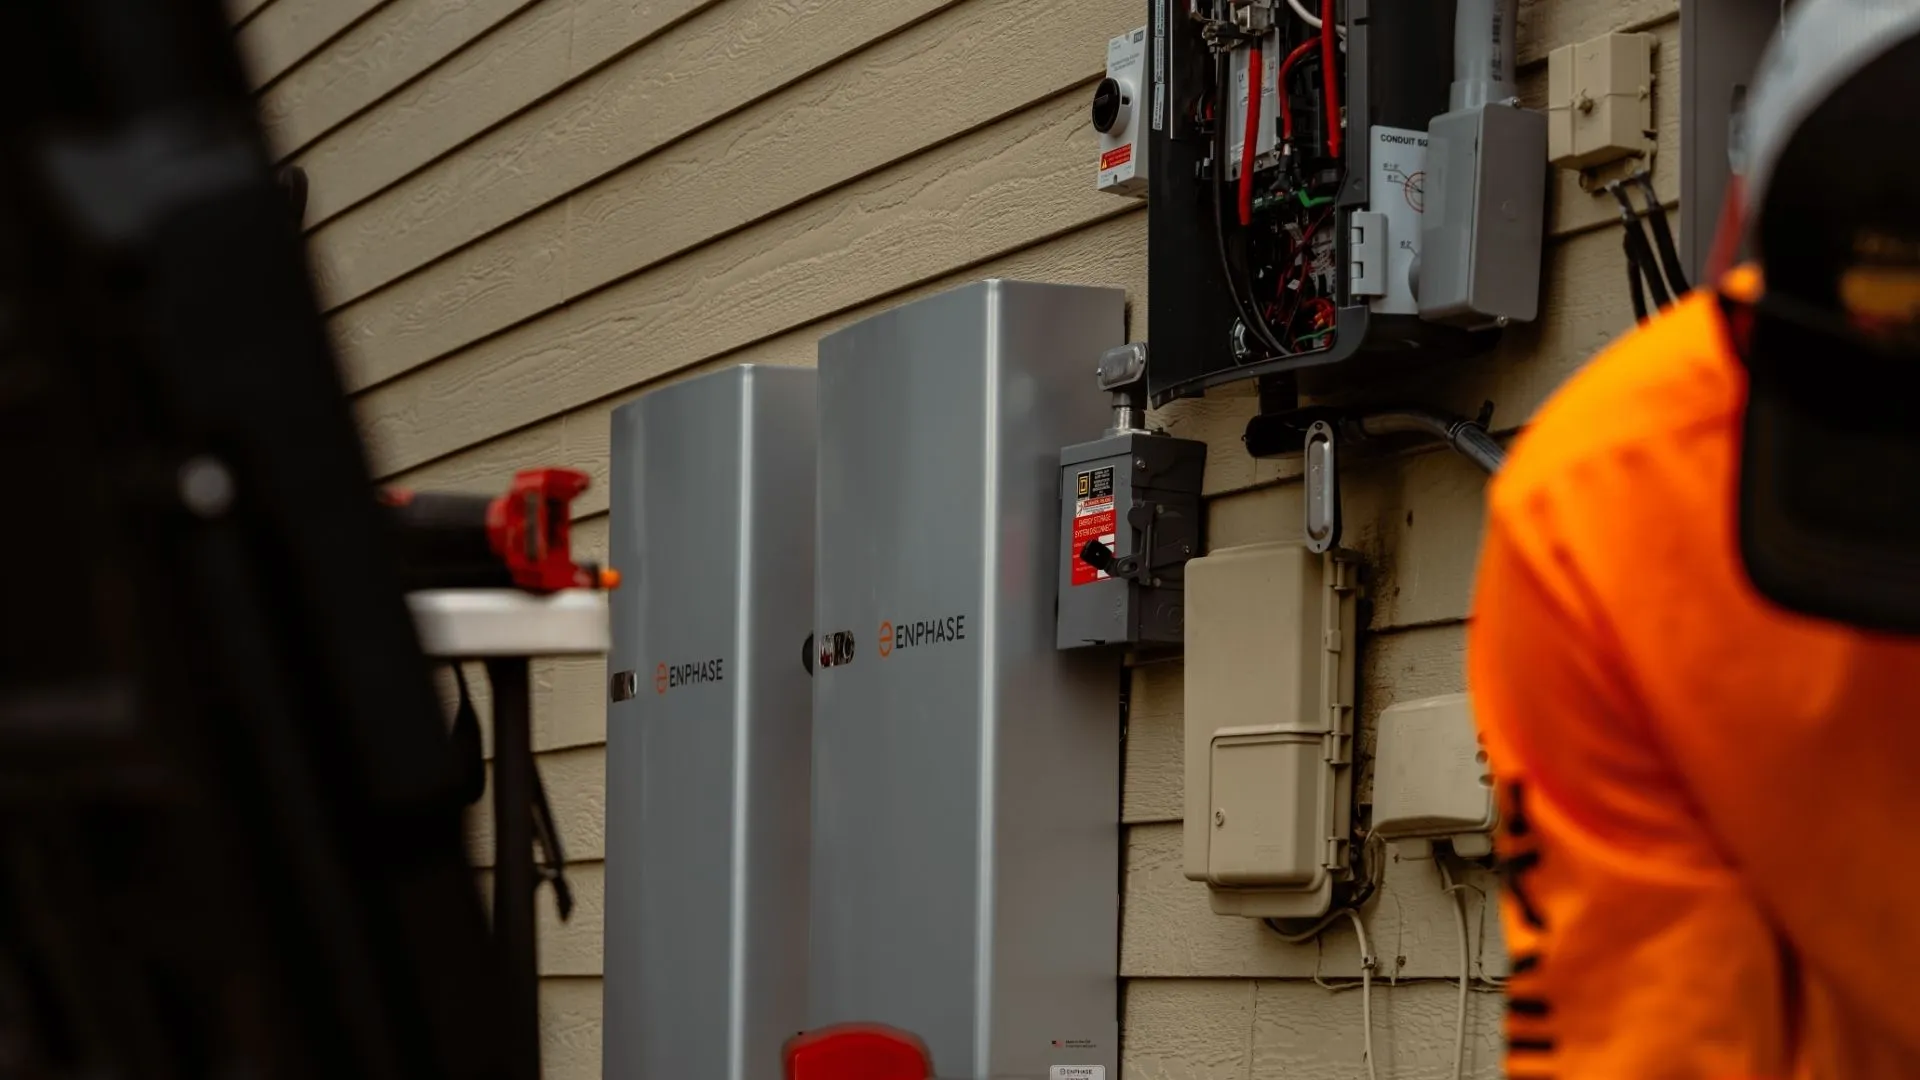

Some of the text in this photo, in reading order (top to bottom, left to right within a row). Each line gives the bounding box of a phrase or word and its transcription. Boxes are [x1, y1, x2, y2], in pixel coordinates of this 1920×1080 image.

[1380, 134, 1415, 145] CONDUIT
[896, 615, 965, 649] ENPHASE
[670, 658, 723, 688] ENPHASE
